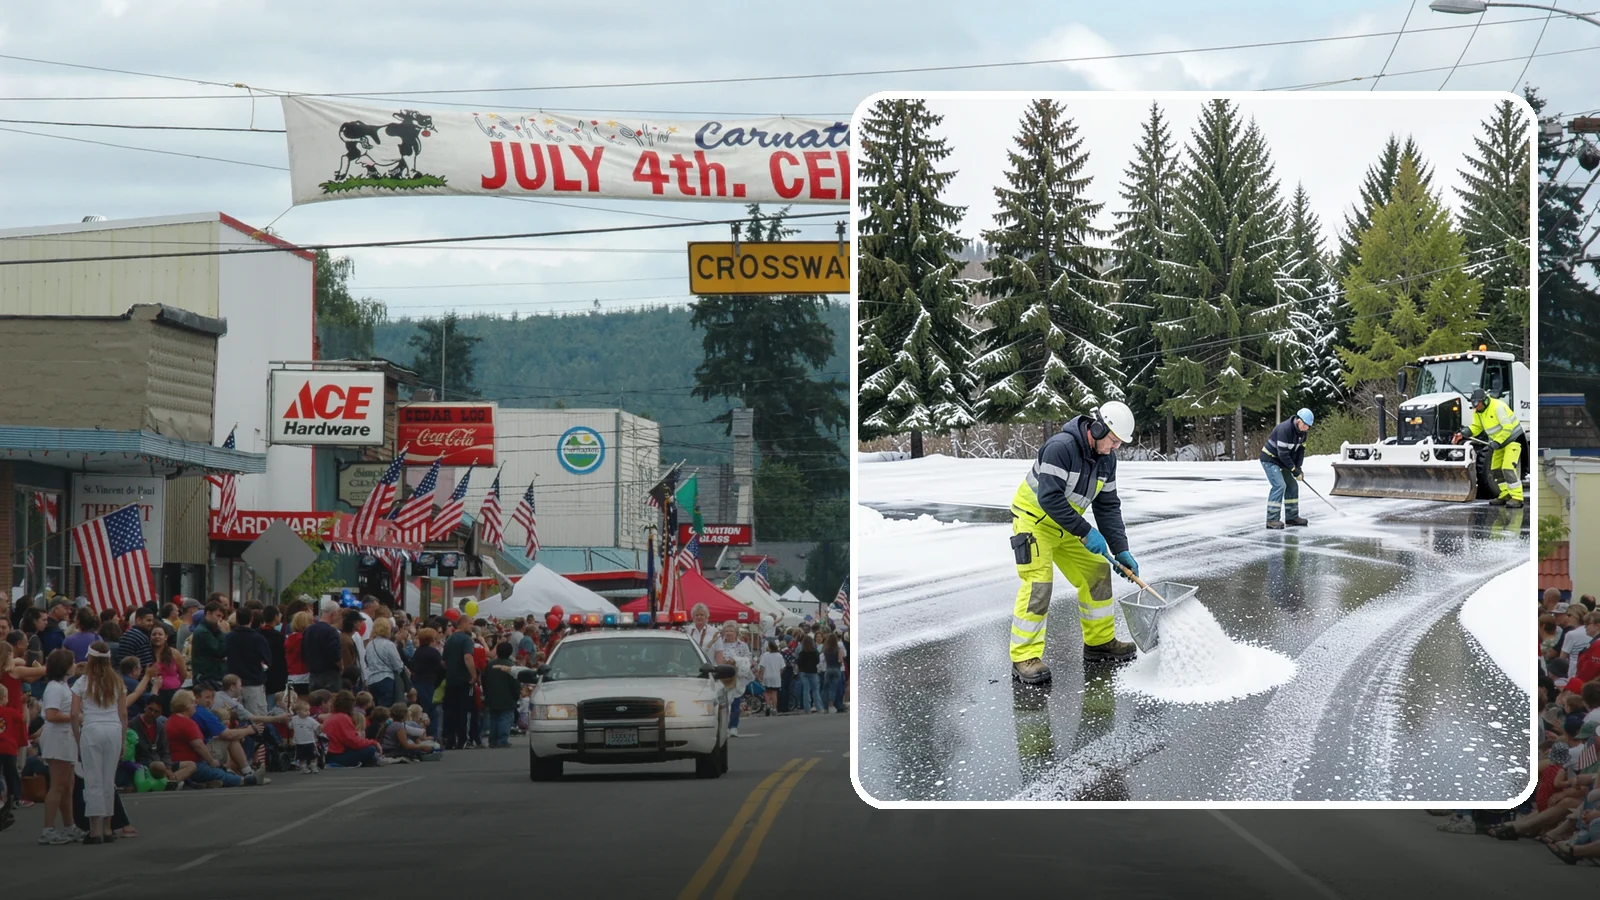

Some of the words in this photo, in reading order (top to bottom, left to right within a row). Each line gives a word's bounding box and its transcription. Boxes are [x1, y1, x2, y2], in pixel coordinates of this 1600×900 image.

[695, 120, 850, 150] Carnat
[481, 141, 605, 192] JULY
[632, 150, 746, 198] 4th.
[697, 254, 850, 280] CROSSWA
[282, 380, 373, 420] ACE
[405, 409, 452, 422] CEDAR
[461, 409, 485, 422] LOG
[283, 421, 371, 437] Hardware
[416, 428, 477, 447] Coca-Cola
[353, 467, 389, 479] Simpl
[83, 485, 94, 494] St.
[96, 485, 124, 495] Vincent
[126, 485, 136, 495] de
[138, 486, 155, 495] Paul
[688, 526, 741, 535] CRNATION
[699, 535, 730, 543] GLASS
